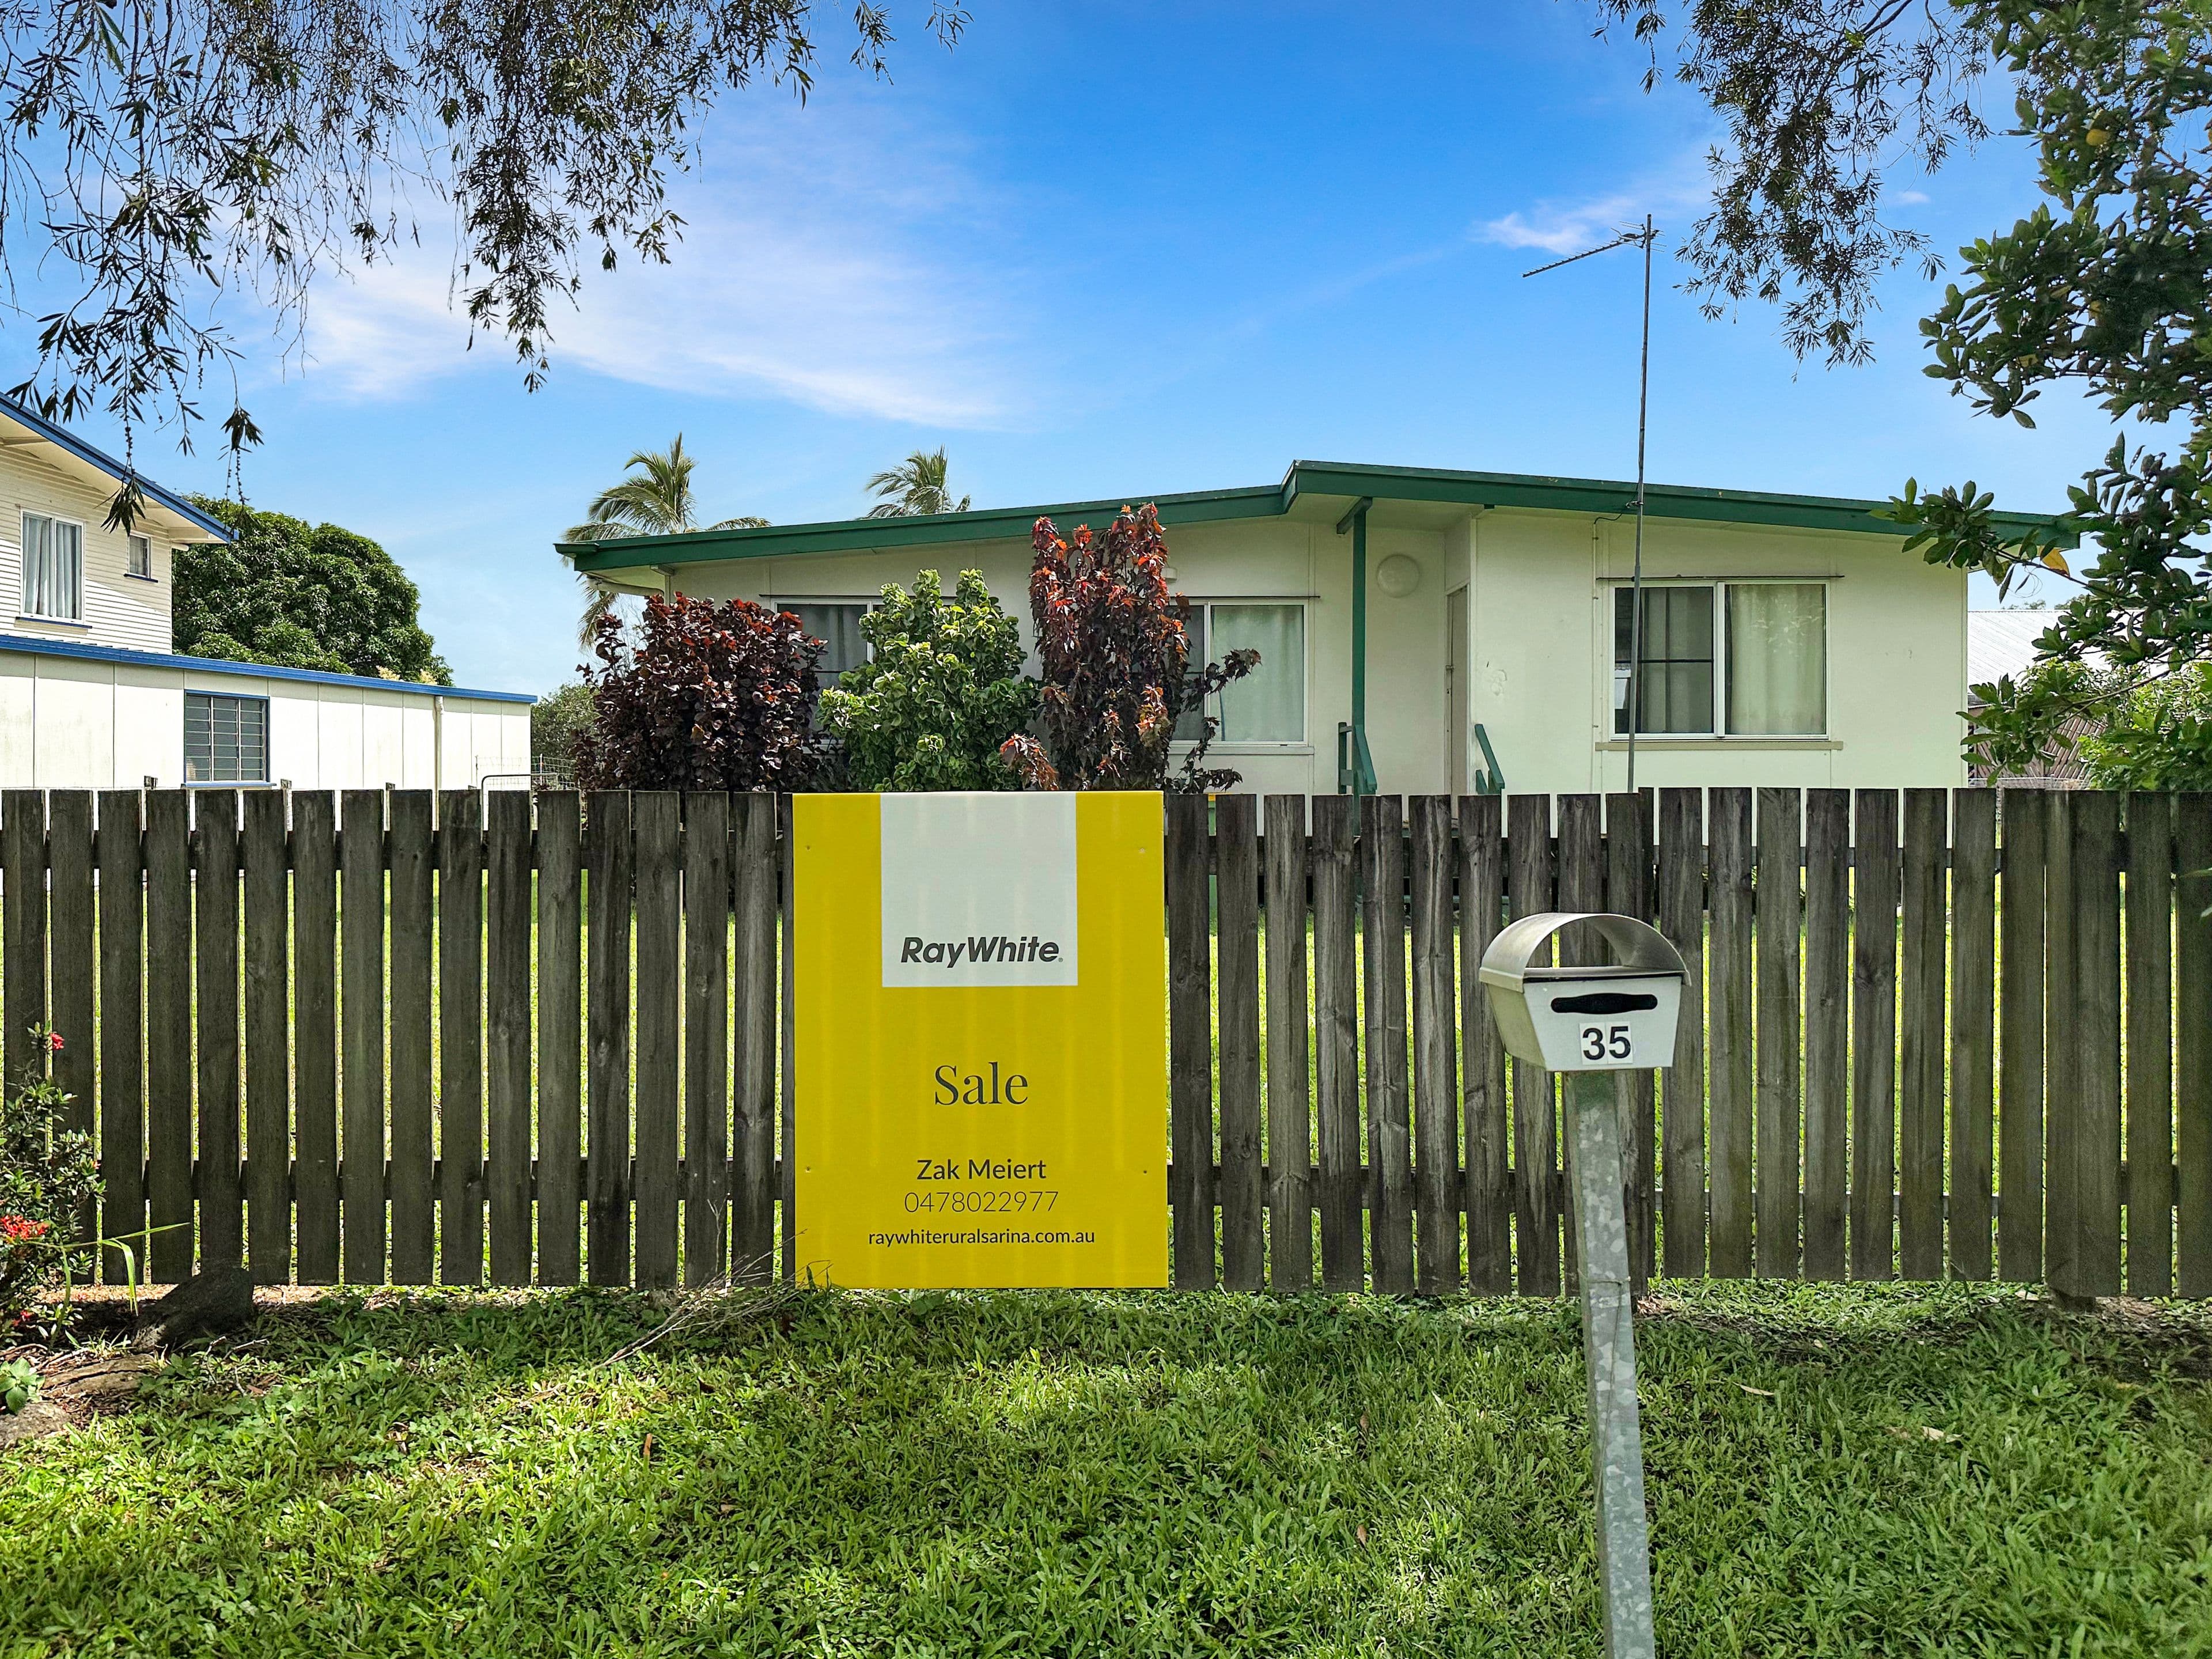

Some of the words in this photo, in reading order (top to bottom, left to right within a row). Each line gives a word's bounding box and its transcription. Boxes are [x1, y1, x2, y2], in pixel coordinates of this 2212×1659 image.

[1582, 1025, 1631, 1060] 35
[935, 1061, 1028, 1105] Sale
[916, 1158, 960, 1180] Zak
[968, 1158, 1047, 1180] Meiert
[904, 1191, 1059, 1213] 0478022977
[869, 1228, 1094, 1248] raywhiteruralsarina.com.au
